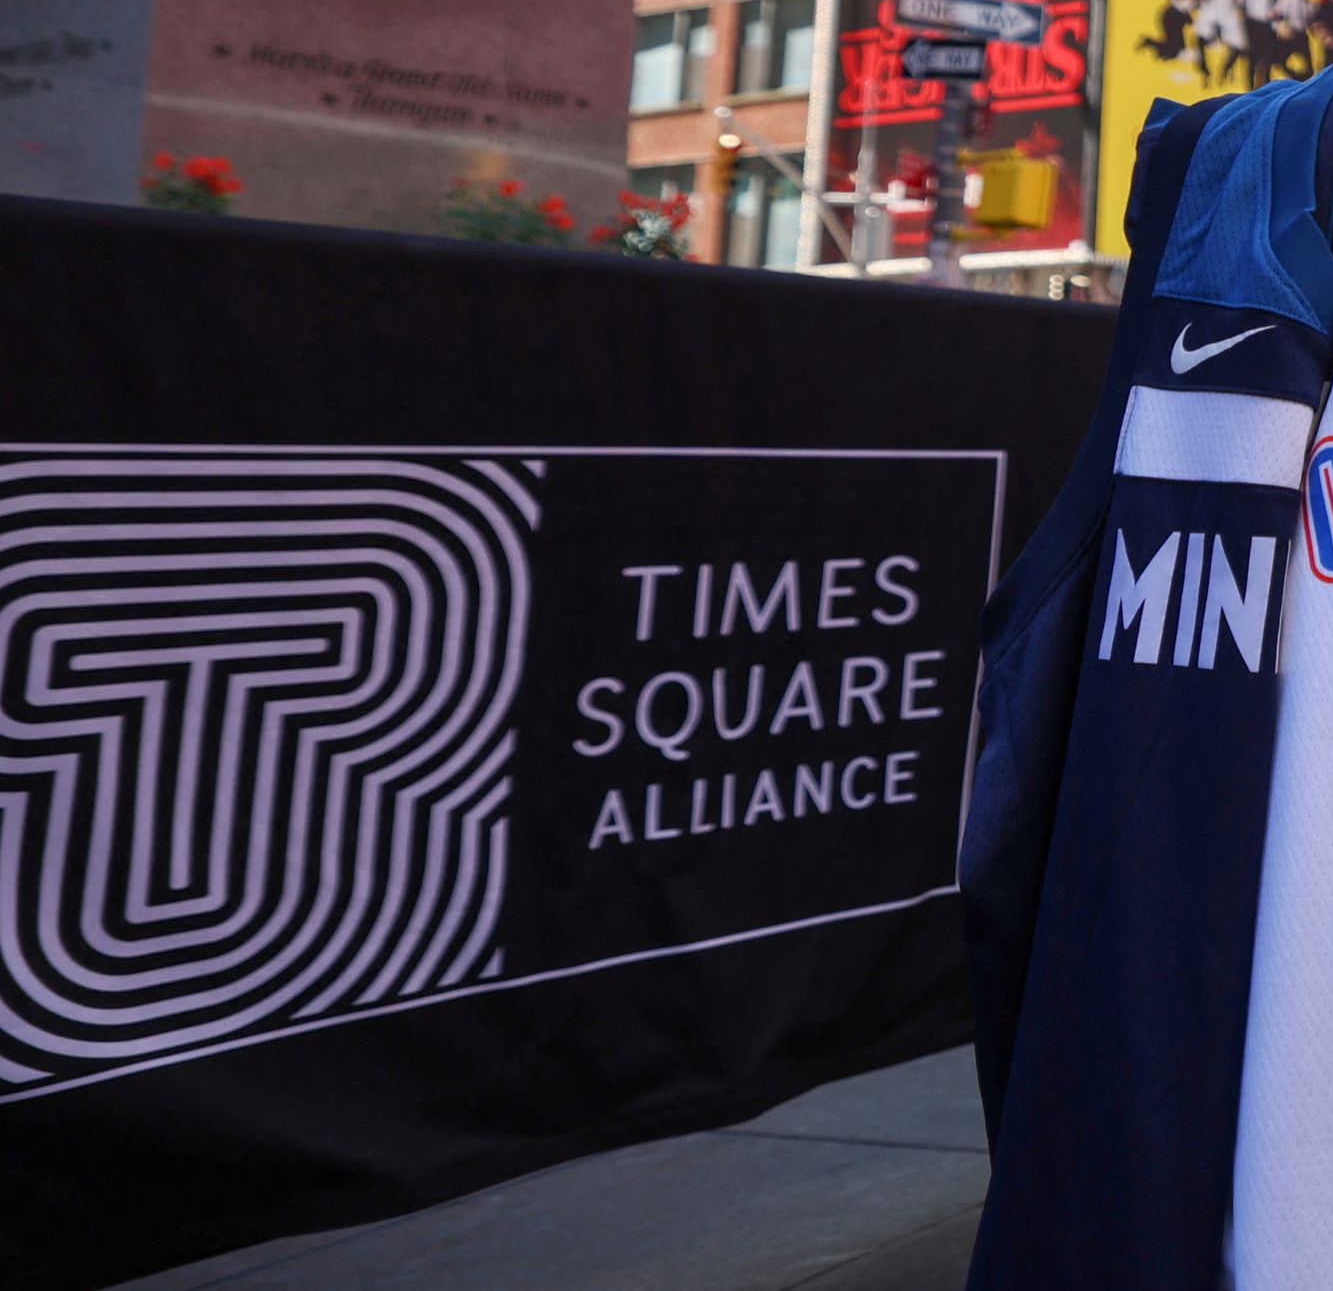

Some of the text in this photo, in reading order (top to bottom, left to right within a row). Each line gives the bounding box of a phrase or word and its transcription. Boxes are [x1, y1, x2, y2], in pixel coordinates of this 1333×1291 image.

[976, 6, 1018, 28] WAY
[622, 555, 920, 641] TIMES
[1098, 527, 1291, 674] MIN
[571, 650, 946, 763] SQUARE
[589, 751, 918, 850] ALLIANCE
